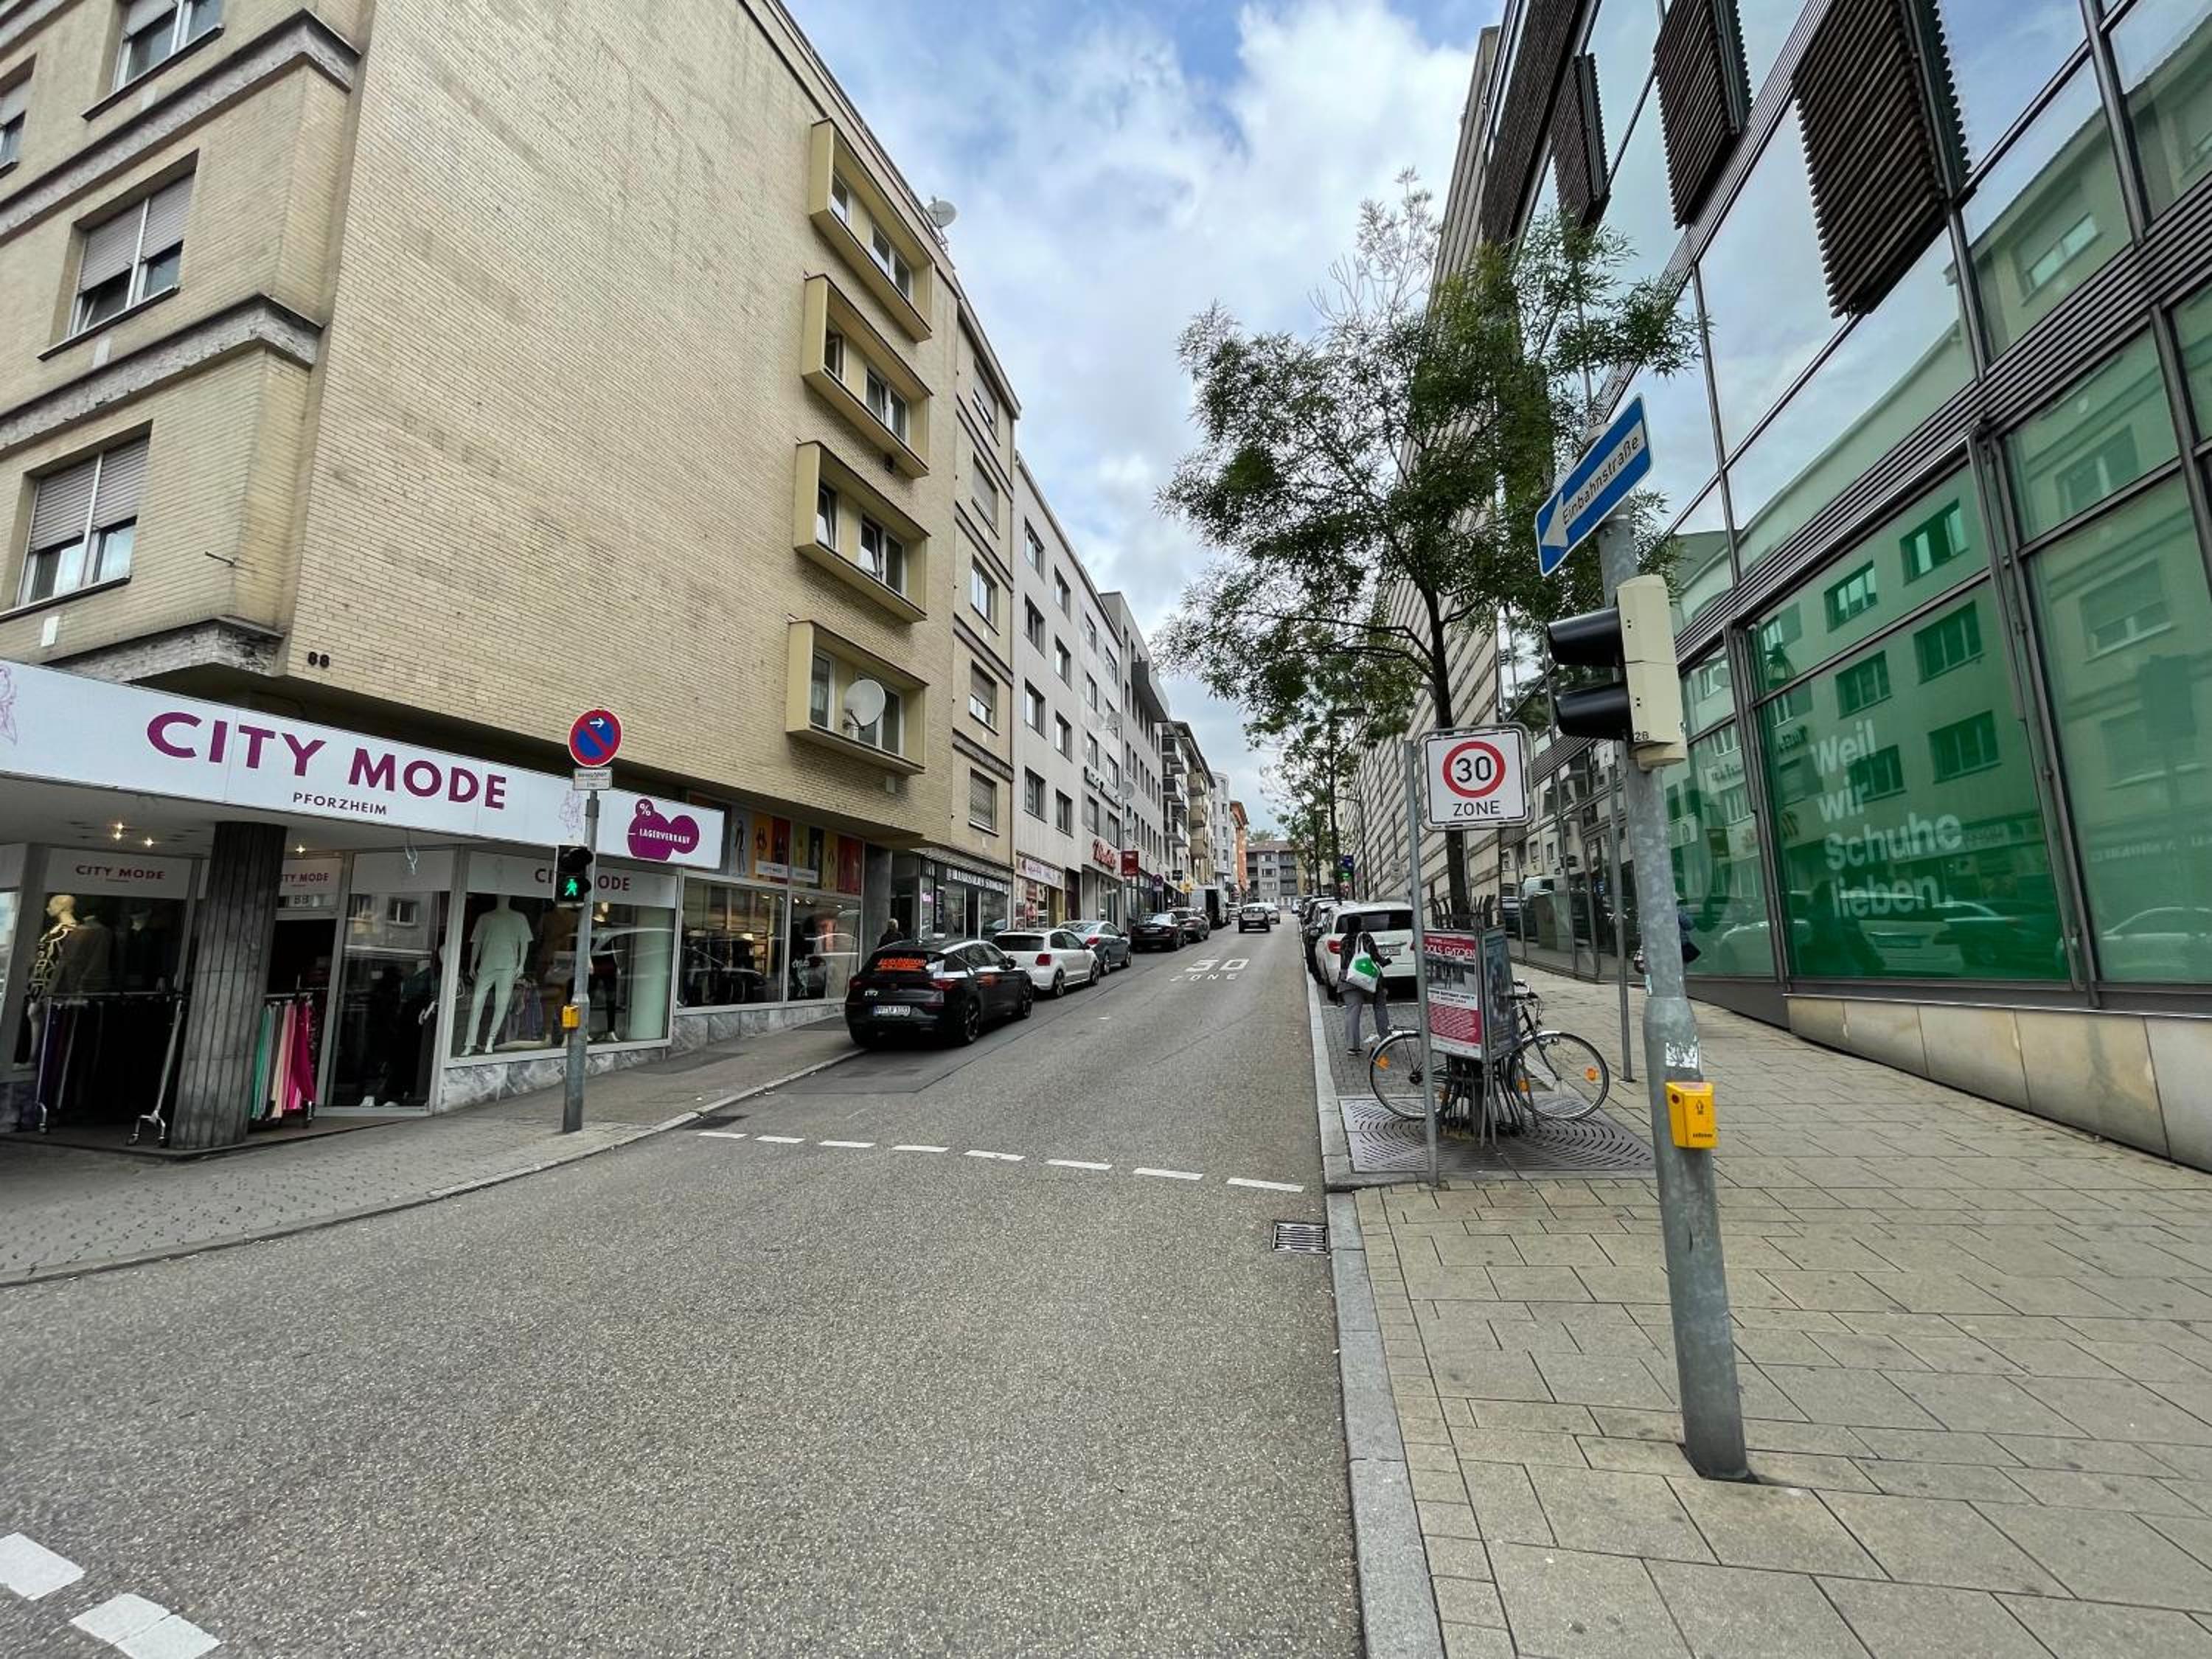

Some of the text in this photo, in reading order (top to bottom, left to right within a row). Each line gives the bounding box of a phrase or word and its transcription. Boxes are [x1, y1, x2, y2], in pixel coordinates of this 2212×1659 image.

[1562, 436, 1639, 525] Einbahnstraße
[1810, 719, 1877, 777] Weil
[147, 712, 507, 810] CITY MODE
[1455, 756, 1492, 783] 30
[293, 792, 388, 815] PFORZHEIM
[1453, 800, 1501, 817] ZONE
[1816, 775, 1868, 823] wir
[639, 803, 652, 817] %
[639, 828, 691, 844] LAGERVERKAUF
[1824, 812, 1962, 870] Schuhe
[75, 865, 166, 880] CITY MODE
[299, 872, 329, 882] MODE
[597, 874, 631, 891] ODE
[1830, 874, 1955, 921] lieben.
[1185, 959, 1250, 972] 30
[1169, 973, 1238, 981] ZONE
